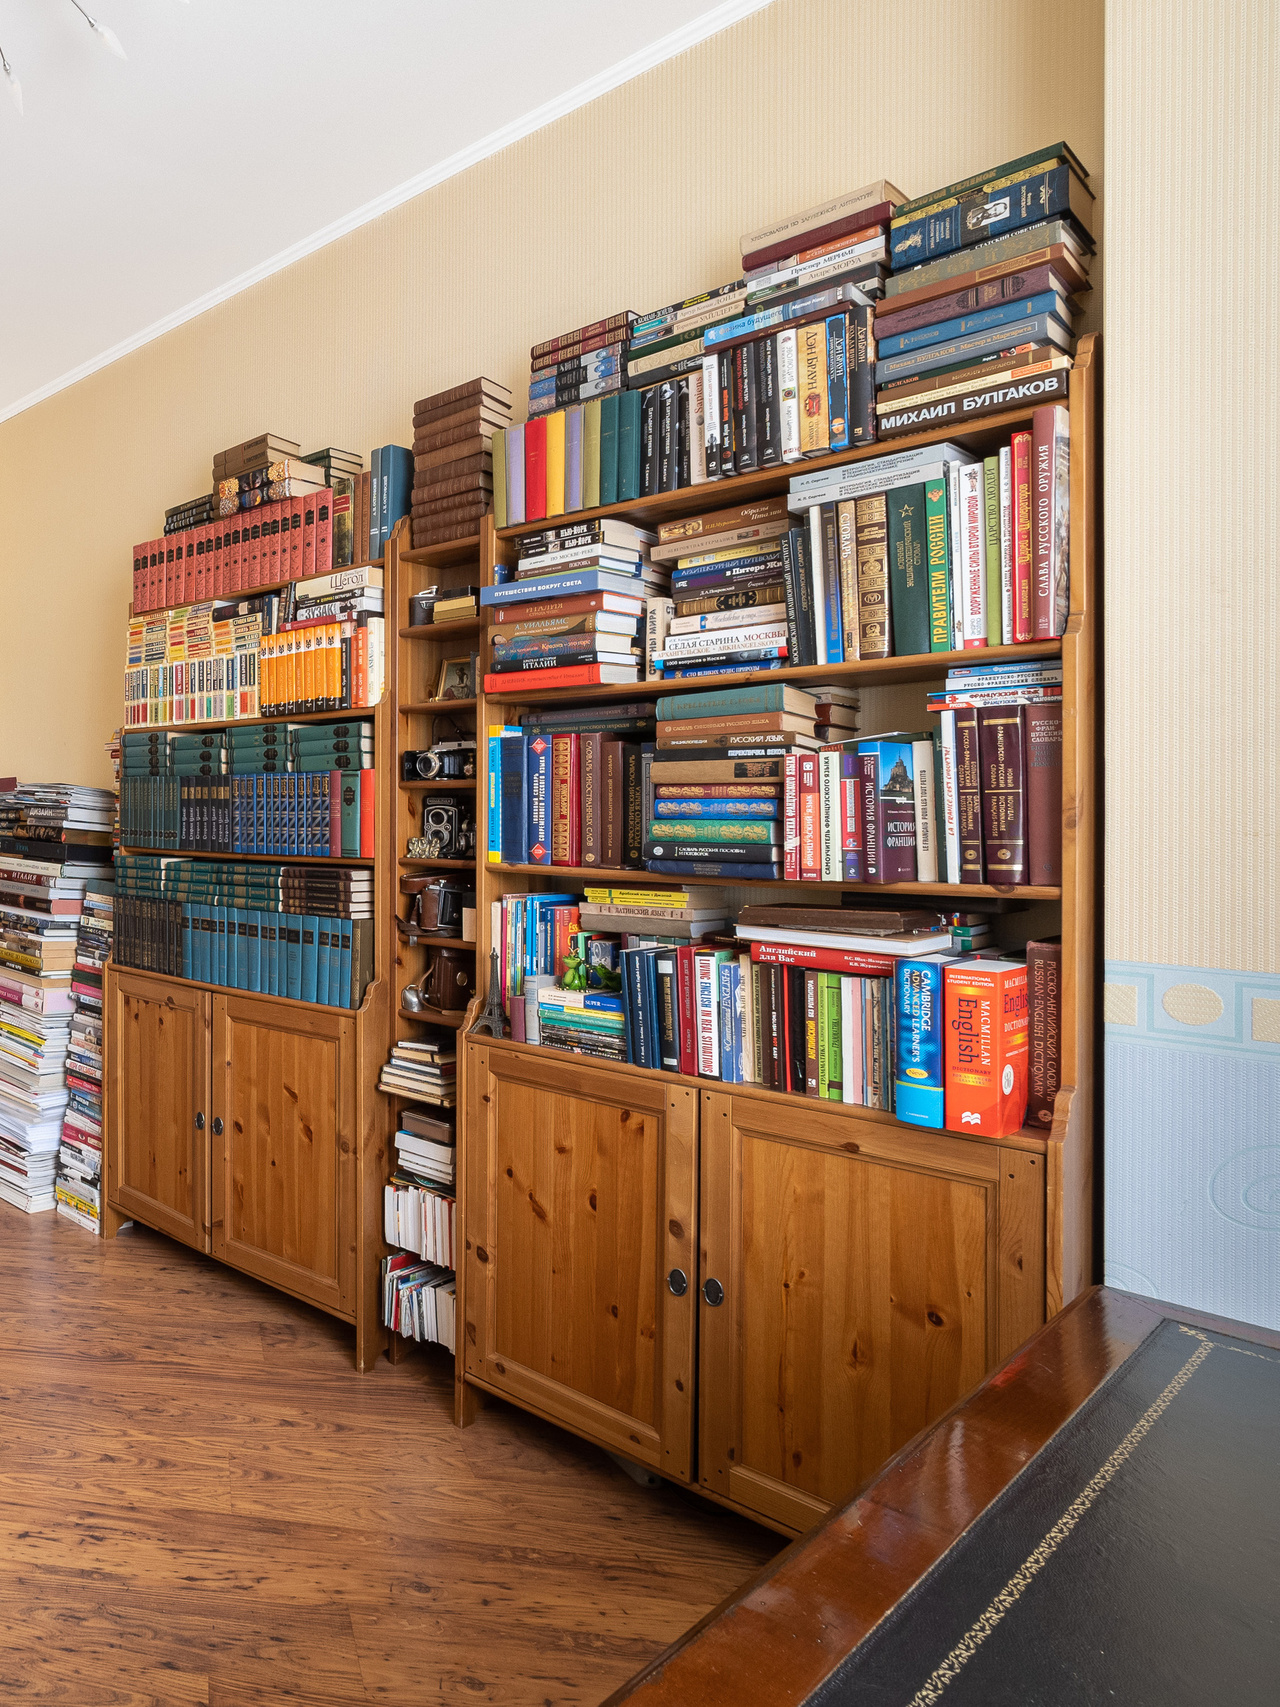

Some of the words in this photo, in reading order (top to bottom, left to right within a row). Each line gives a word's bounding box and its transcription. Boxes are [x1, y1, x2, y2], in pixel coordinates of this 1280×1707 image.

[751, 223, 789, 242] ХРЕСТОМАТИЯ
[790, 220, 800, 228] ПО
[800, 204, 837, 224] ЗАРУБЕЖНОЙ
[791, 261, 821, 275] Проспер
[823, 248, 856, 264] МЕРИМЕ
[808, 267, 831, 280] Андре
[832, 257, 862, 272] МОРУА
[694, 377, 702, 413] Sapiens
[881, 402, 956, 430] МИХАИЛ
[963, 377, 1059, 411] БУЛГАКОВ
[1038, 444, 1049, 492] ОРУЖИЯ
[985, 467, 996, 502] ЛЮДЕЙ
[968, 494, 979, 522] МИРОВОЙ
[840, 513, 851, 559] СЛОВАРЬ
[969, 522, 979, 549] ВТОРОЙ
[988, 504, 998, 547] ЦАРСТВО
[1038, 497, 1050, 555] РУССКОГО
[929, 514, 945, 565] РОССИИ
[560, 548, 594, 560] МОСКВЕ-РЕКЕ
[569, 560, 591, 568] ПОКРОВКА
[782, 539, 790, 570] ИНСТИТУТ
[970, 550, 980, 567] СИЛЫ
[330, 572, 364, 591] Щегол
[494, 587, 536, 597] ПУТЕШЕСТВИЯ
[537, 582, 561, 591] ВОКРУГ
[562, 579, 582, 587] СВЕТА
[1038, 556, 1050, 597] СЛАВА
[785, 571, 795, 616] АВИАЦИОННЫЙ
[970, 567, 982, 616] ВООРУЖЕННЫЕ
[304, 604, 334, 620] ЗУЗАК
[931, 567, 947, 644] ПРАВИТЕЛИ
[523, 617, 569, 629] УИЛЛЬЯМС
[669, 639, 697, 651] СЕДАЯ
[698, 636, 740, 647] СТАРИНА
[743, 629, 786, 641] МОСКВЫ
[788, 617, 799, 664] МОСКОВСКИЙ
[523, 660, 557, 669] ИТАЛИИ
[730, 735, 764, 744] РУССКИЙ
[765, 734, 785, 742] ЯЗЫК
[787, 756, 796, 775] ЯЗЫКА
[786, 776, 796, 816] ФРАНЦУЗСКОГО
[866, 782, 874, 822] ИСТОРИЯ
[29, 807, 53, 817] ДИЗАЙН
[887, 821, 916, 833] ИСТОРИЯ
[867, 824, 876, 864] ФРАНЦИИ
[886, 835, 916, 848] ФРАНЦИИ
[11, 871, 37, 881] ИТАЛИЯ
[615, 906, 651, 916] ЛАТИНСКИЙ
[652, 908, 667, 917] ЯЗЫК
[759, 945, 817, 958] Английский
[759, 954, 775, 962] для
[778, 955, 795, 963] Вас
[949, 974, 992, 982] INTERNATIONAL
[704, 982, 712, 1009] ENGLISH
[912, 970, 921, 1017] ADVANCED
[921, 970, 931, 1032] CAMBRIDGE
[704, 1019, 712, 1035] REAL
[912, 1018, 921, 1063] LEARNER'S
[951, 997, 978, 1064] English
[981, 1000, 991, 1066] MACMILLAN
[702, 1035, 713, 1074] SITUATIONS
[952, 1066, 992, 1075] DICTIONARY
